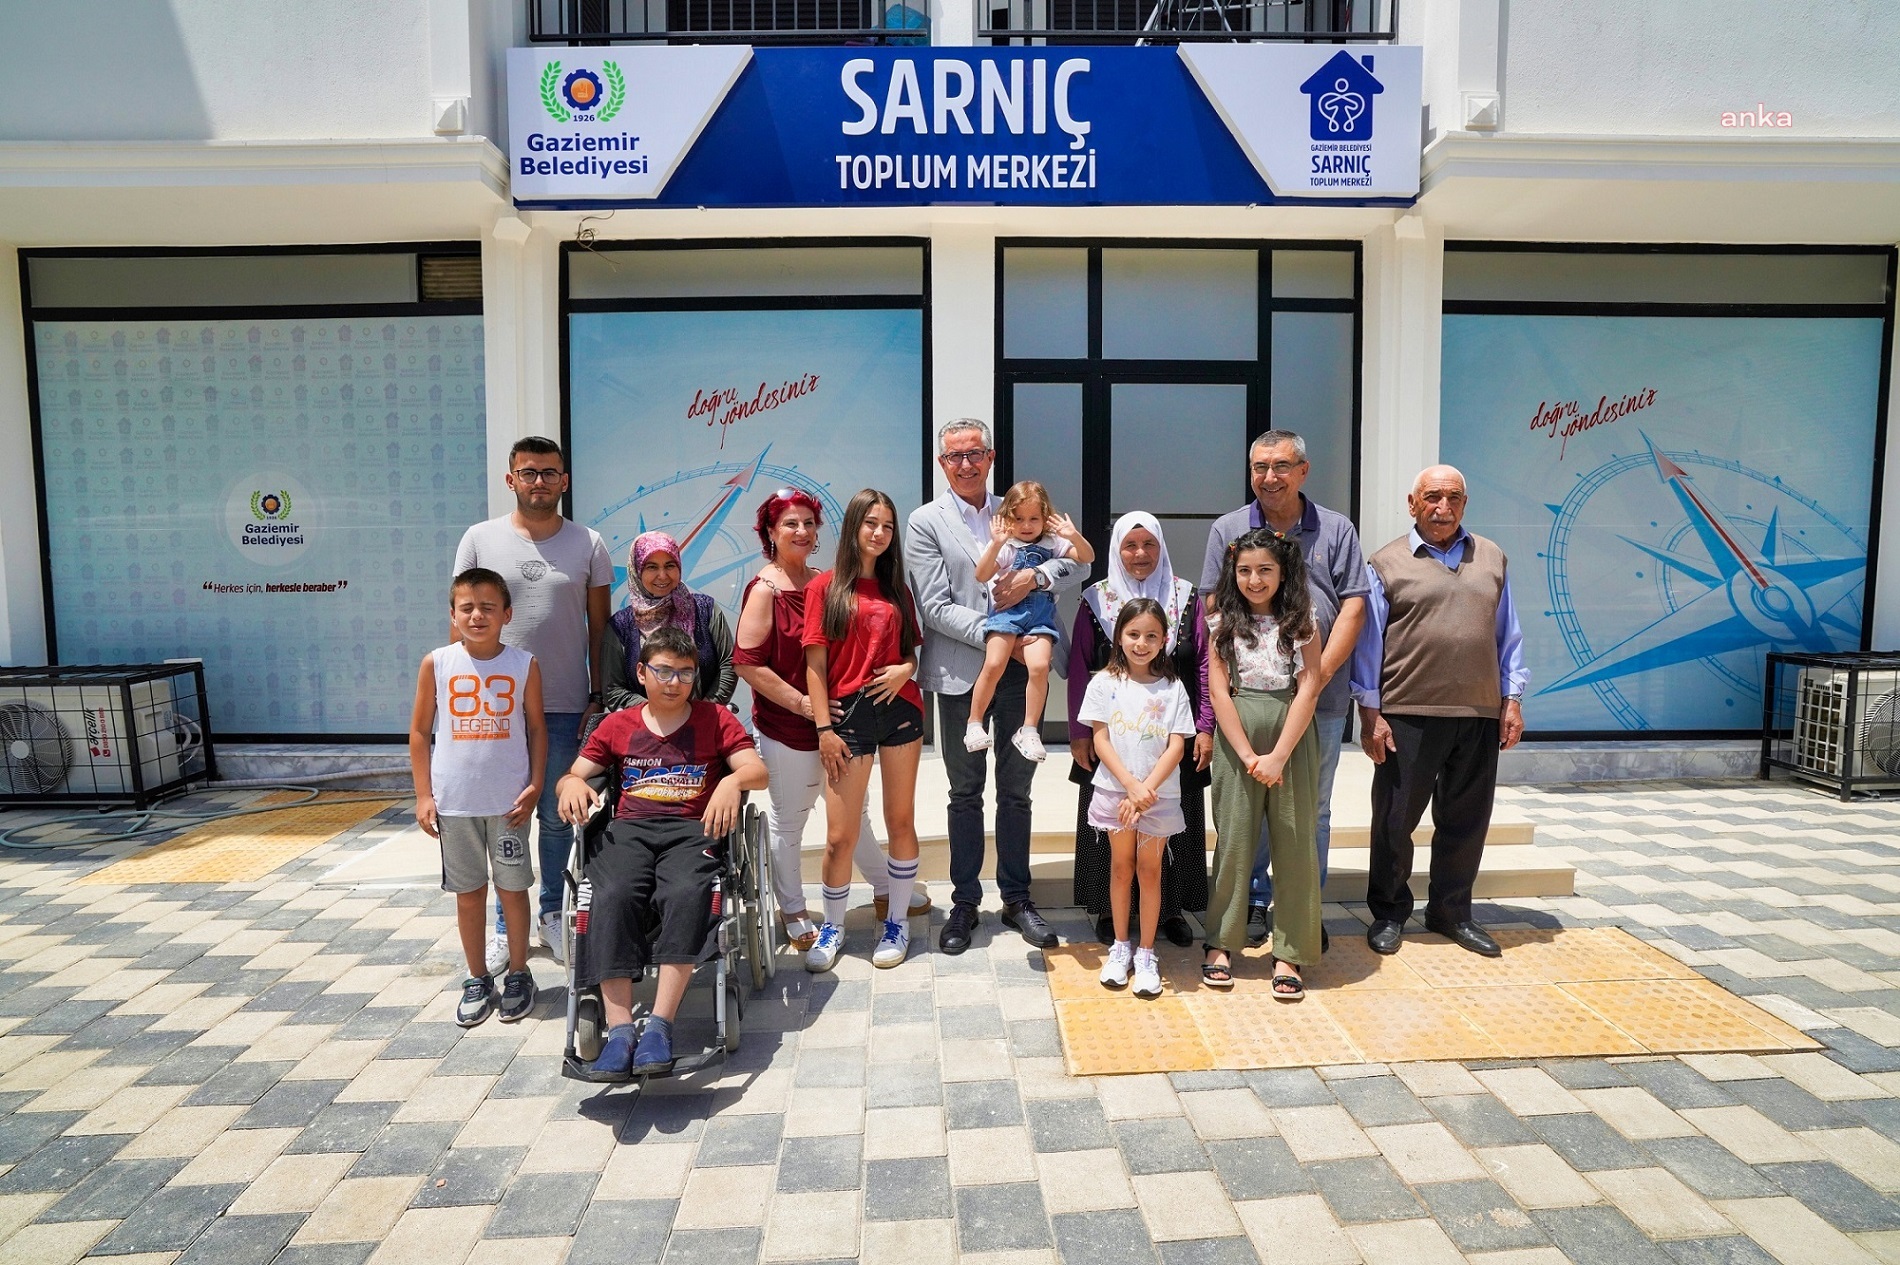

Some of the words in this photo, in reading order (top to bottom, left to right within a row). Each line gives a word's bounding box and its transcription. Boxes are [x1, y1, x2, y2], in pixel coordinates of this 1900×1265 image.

[840, 58, 1091, 150] SARNIÇ
[573, 114, 595, 122] 1926
[527, 132, 640, 152] Gaziemir
[520, 155, 648, 179] Belediyesi
[835, 155, 957, 189] TOPLUM
[967, 149, 1096, 188] MERKEZİ
[1311, 155, 1371, 176] SARNIÇ
[1310, 177, 1339, 186] TOPLUM
[1340, 177, 1372, 186] MERKEZİ
[687, 388, 738, 426] doğru
[719, 373, 821, 450] yöndesiniz
[1530, 401, 1579, 438] doğru
[1560, 387, 1658, 461] yöndesiniz
[245, 523, 300, 534] Gaziemir
[242, 535, 304, 546] Belediyesi
[265, 582, 301, 593] herkesle
[449, 674, 516, 717] 83
[451, 718, 510, 732] LEGEND
[624, 757, 662, 767] FASHION
